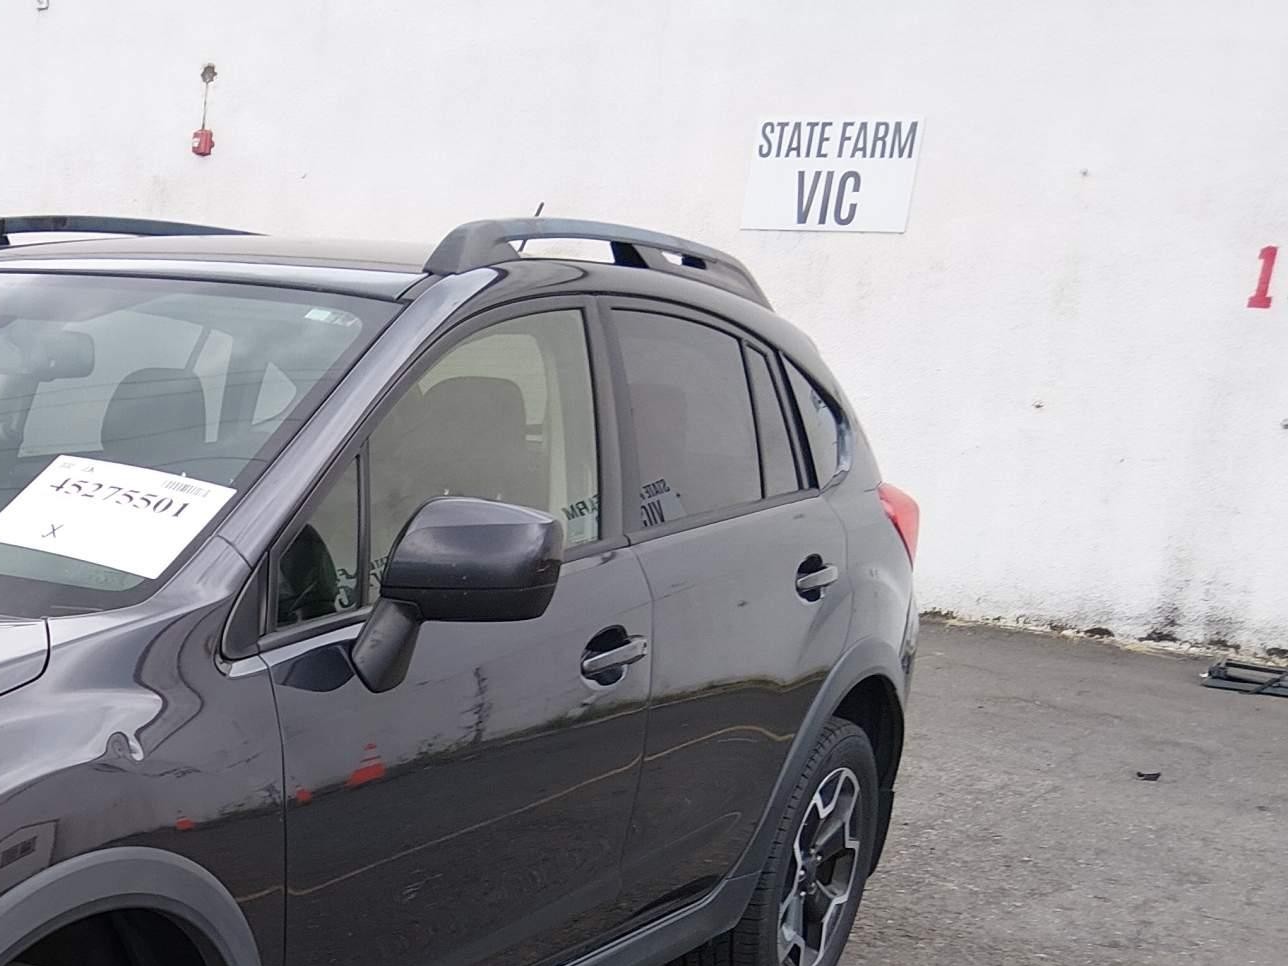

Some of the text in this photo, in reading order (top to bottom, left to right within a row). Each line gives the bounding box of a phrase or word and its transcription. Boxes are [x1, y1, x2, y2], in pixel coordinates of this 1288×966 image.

[758, 121, 918, 159] STATE FARM
[796, 170, 862, 226] VIC
[49, 476, 190, 518] 45275501
